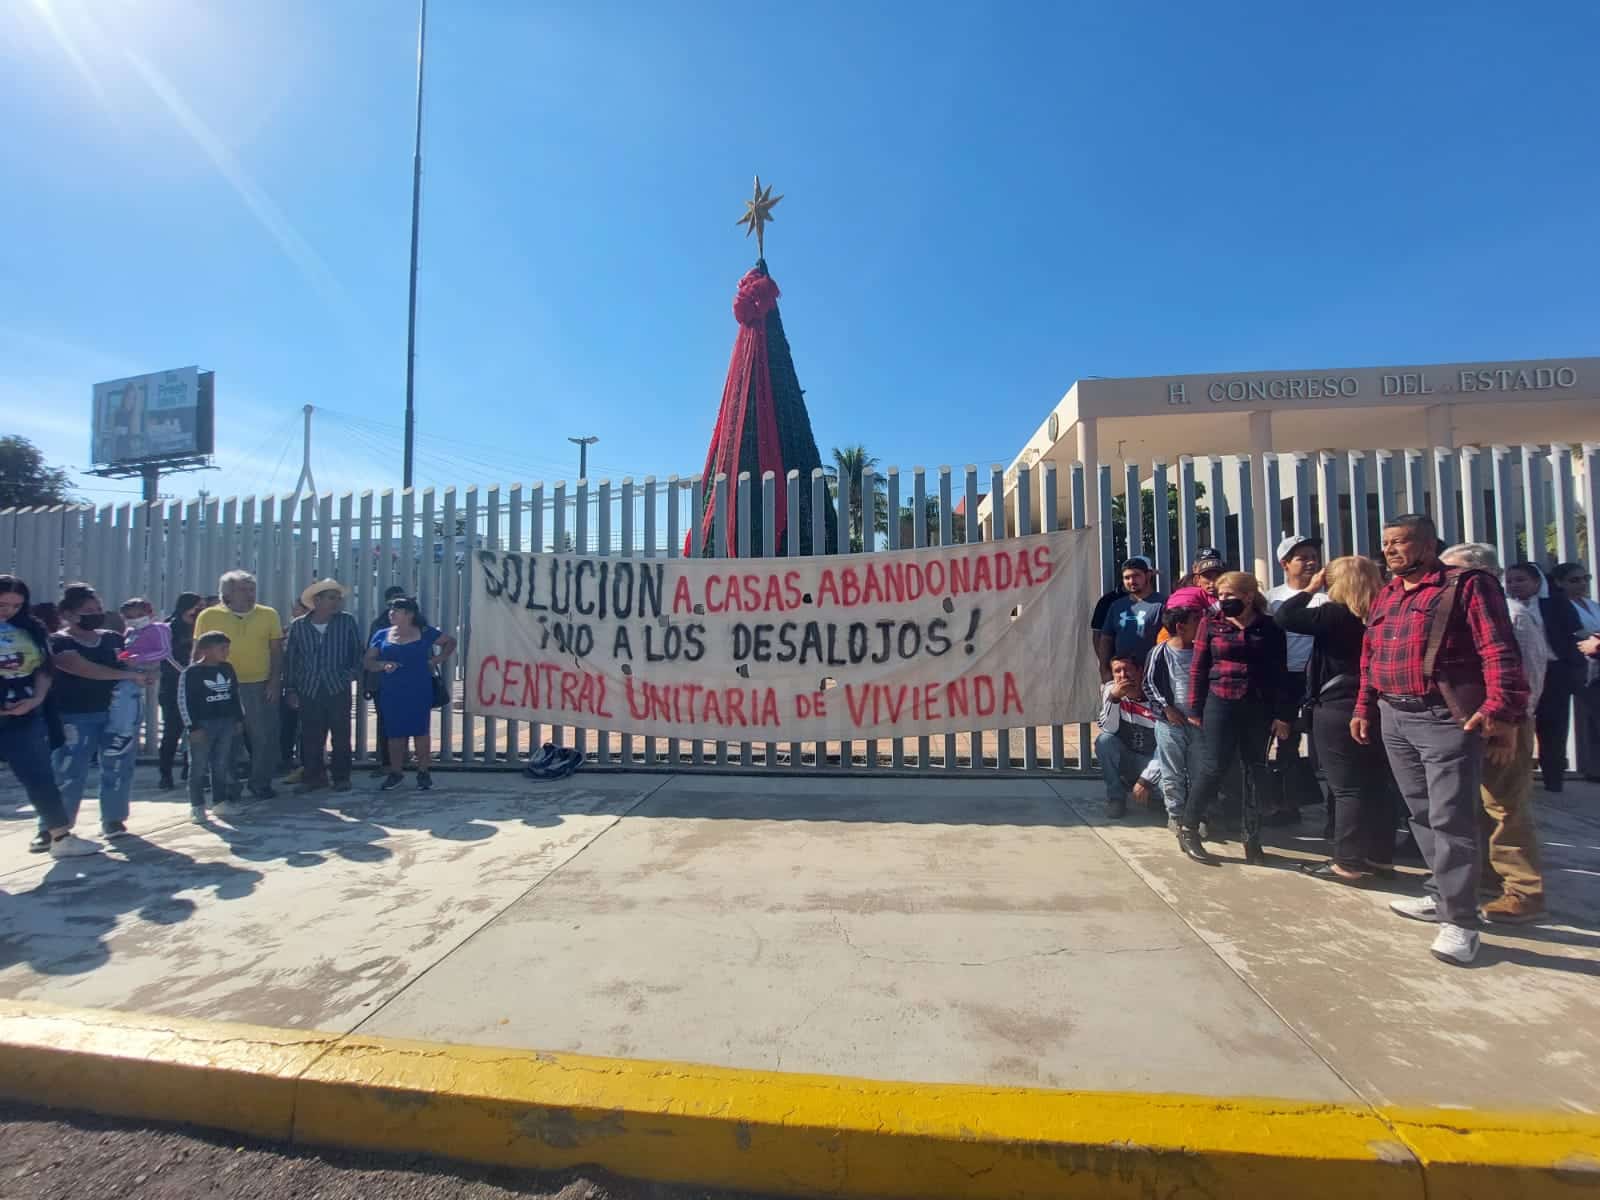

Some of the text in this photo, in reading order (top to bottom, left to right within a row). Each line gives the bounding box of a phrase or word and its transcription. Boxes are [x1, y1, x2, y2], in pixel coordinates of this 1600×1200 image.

[1208, 377, 1359, 403] CONGRESO
[1382, 373, 1434, 396] DEL
[1459, 367, 1577, 393] ESTADO
[478, 545, 1056, 619] SOLUCION A CASAS ABANDONADAS
[613, 625, 633, 661] A
[645, 623, 706, 662] LOS
[478, 655, 613, 719] CENTRAL
[624, 675, 781, 728] UNITARIA
[845, 672, 1024, 728] VIVIENDA
